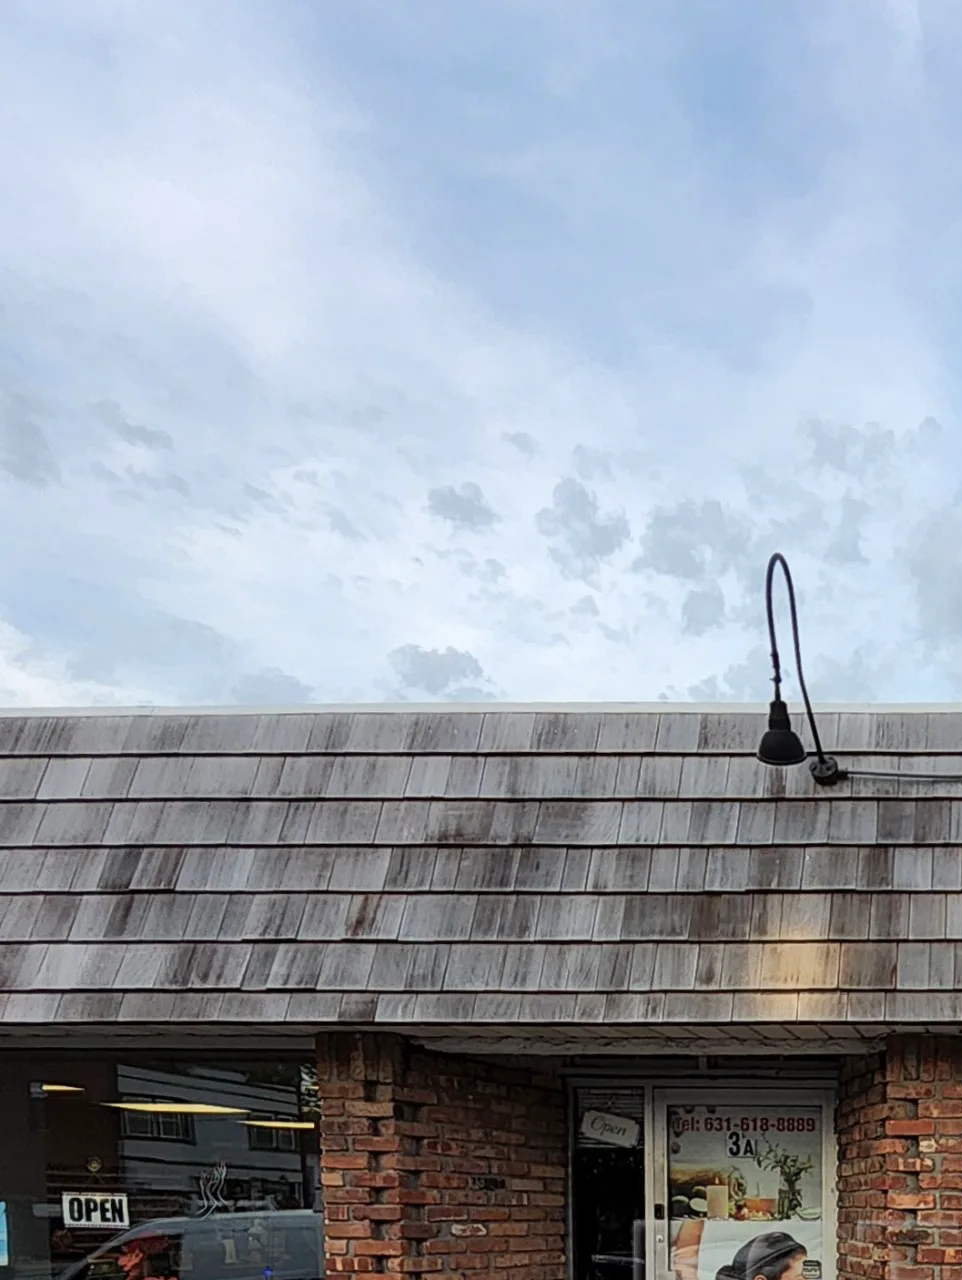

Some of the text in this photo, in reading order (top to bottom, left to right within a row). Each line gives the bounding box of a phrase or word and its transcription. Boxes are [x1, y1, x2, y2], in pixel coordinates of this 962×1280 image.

[590, 1115, 627, 1137] Open
[704, 1116, 816, 1132] 631-618-8889
[68, 1197, 125, 1224] OPEN
